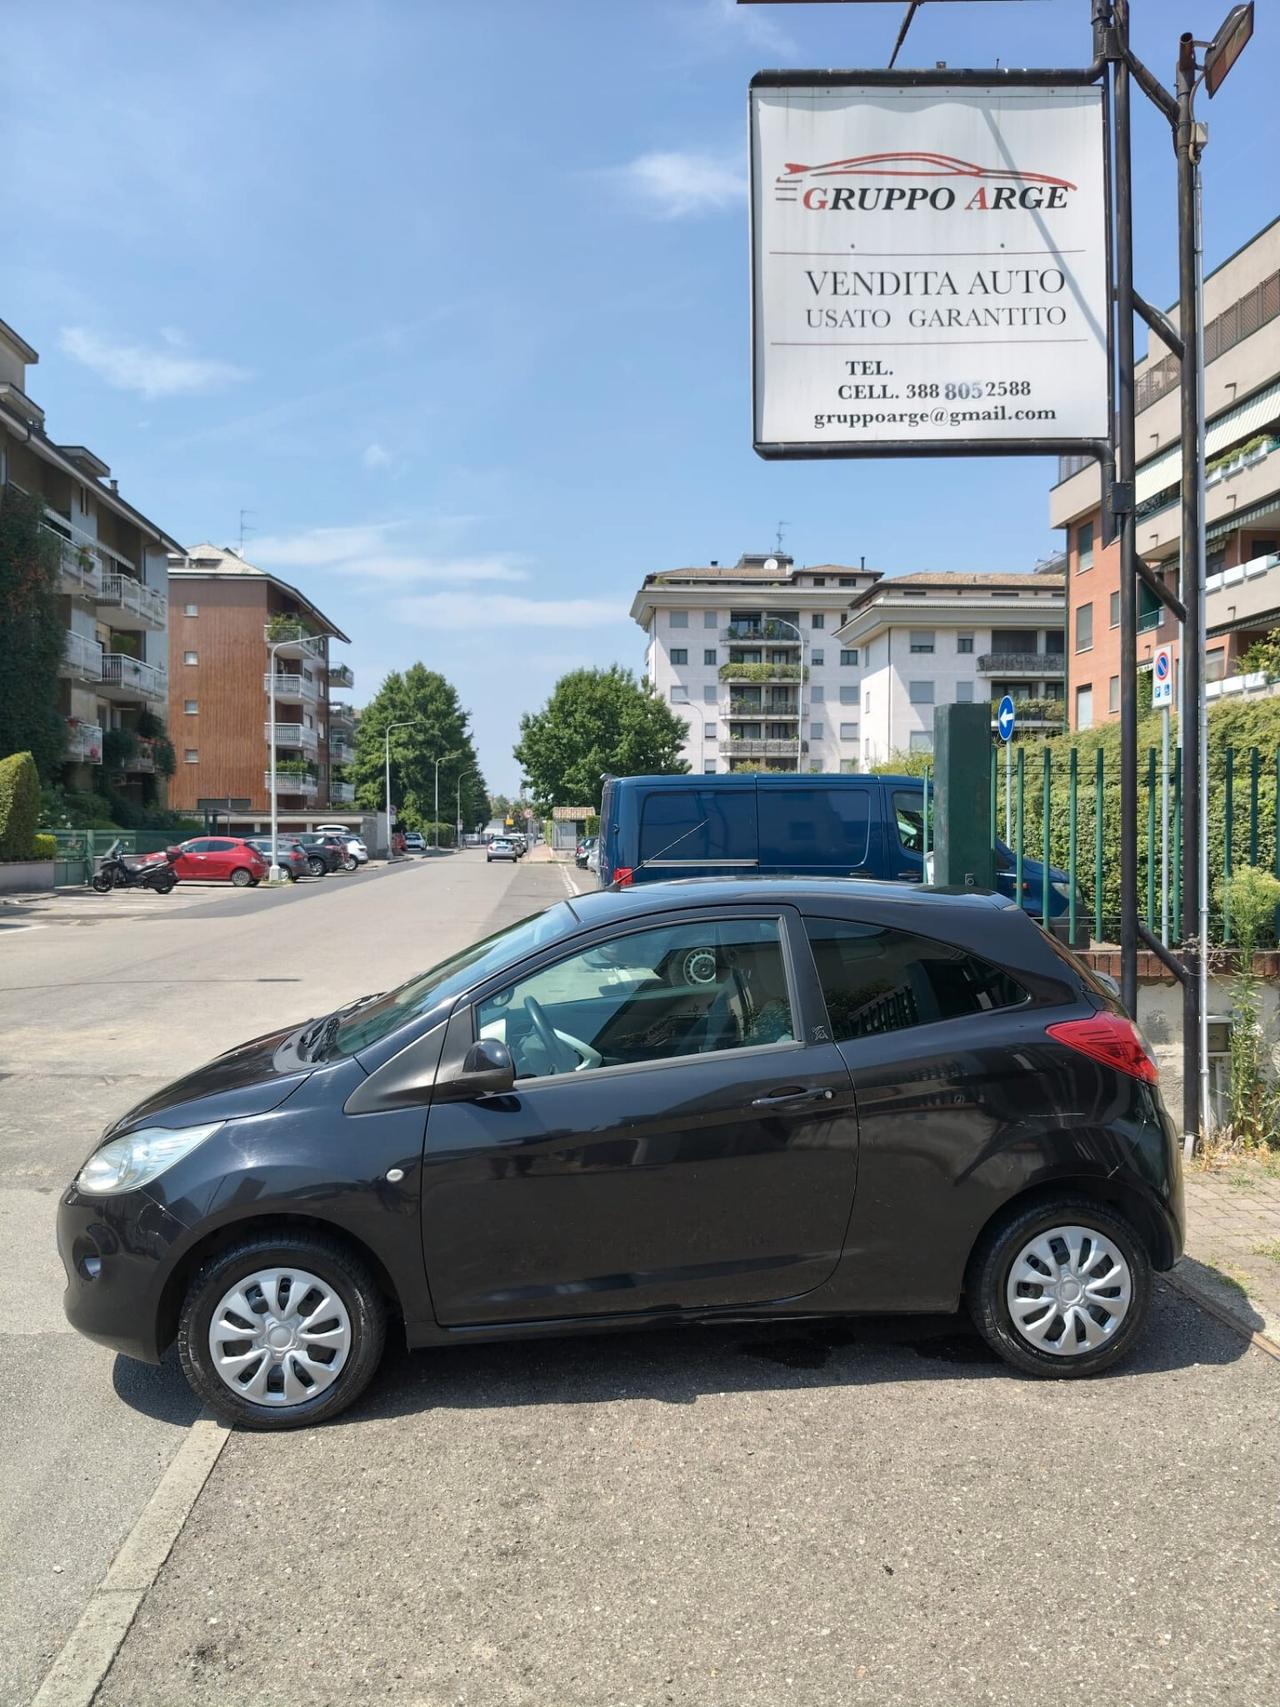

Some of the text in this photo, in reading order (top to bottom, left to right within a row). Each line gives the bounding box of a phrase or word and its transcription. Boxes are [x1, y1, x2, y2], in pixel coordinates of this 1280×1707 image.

[802, 186, 1069, 210] GRUPPO ARGE
[804, 269, 1066, 296] VENDITA AUTO
[806, 306, 1067, 328] USATO GARANTITO
[846, 361, 894, 376] TEL.
[838, 381, 1032, 400] CELL. 388 805 2588
[814, 406, 1057, 429] gruppoarge@gmail.com
